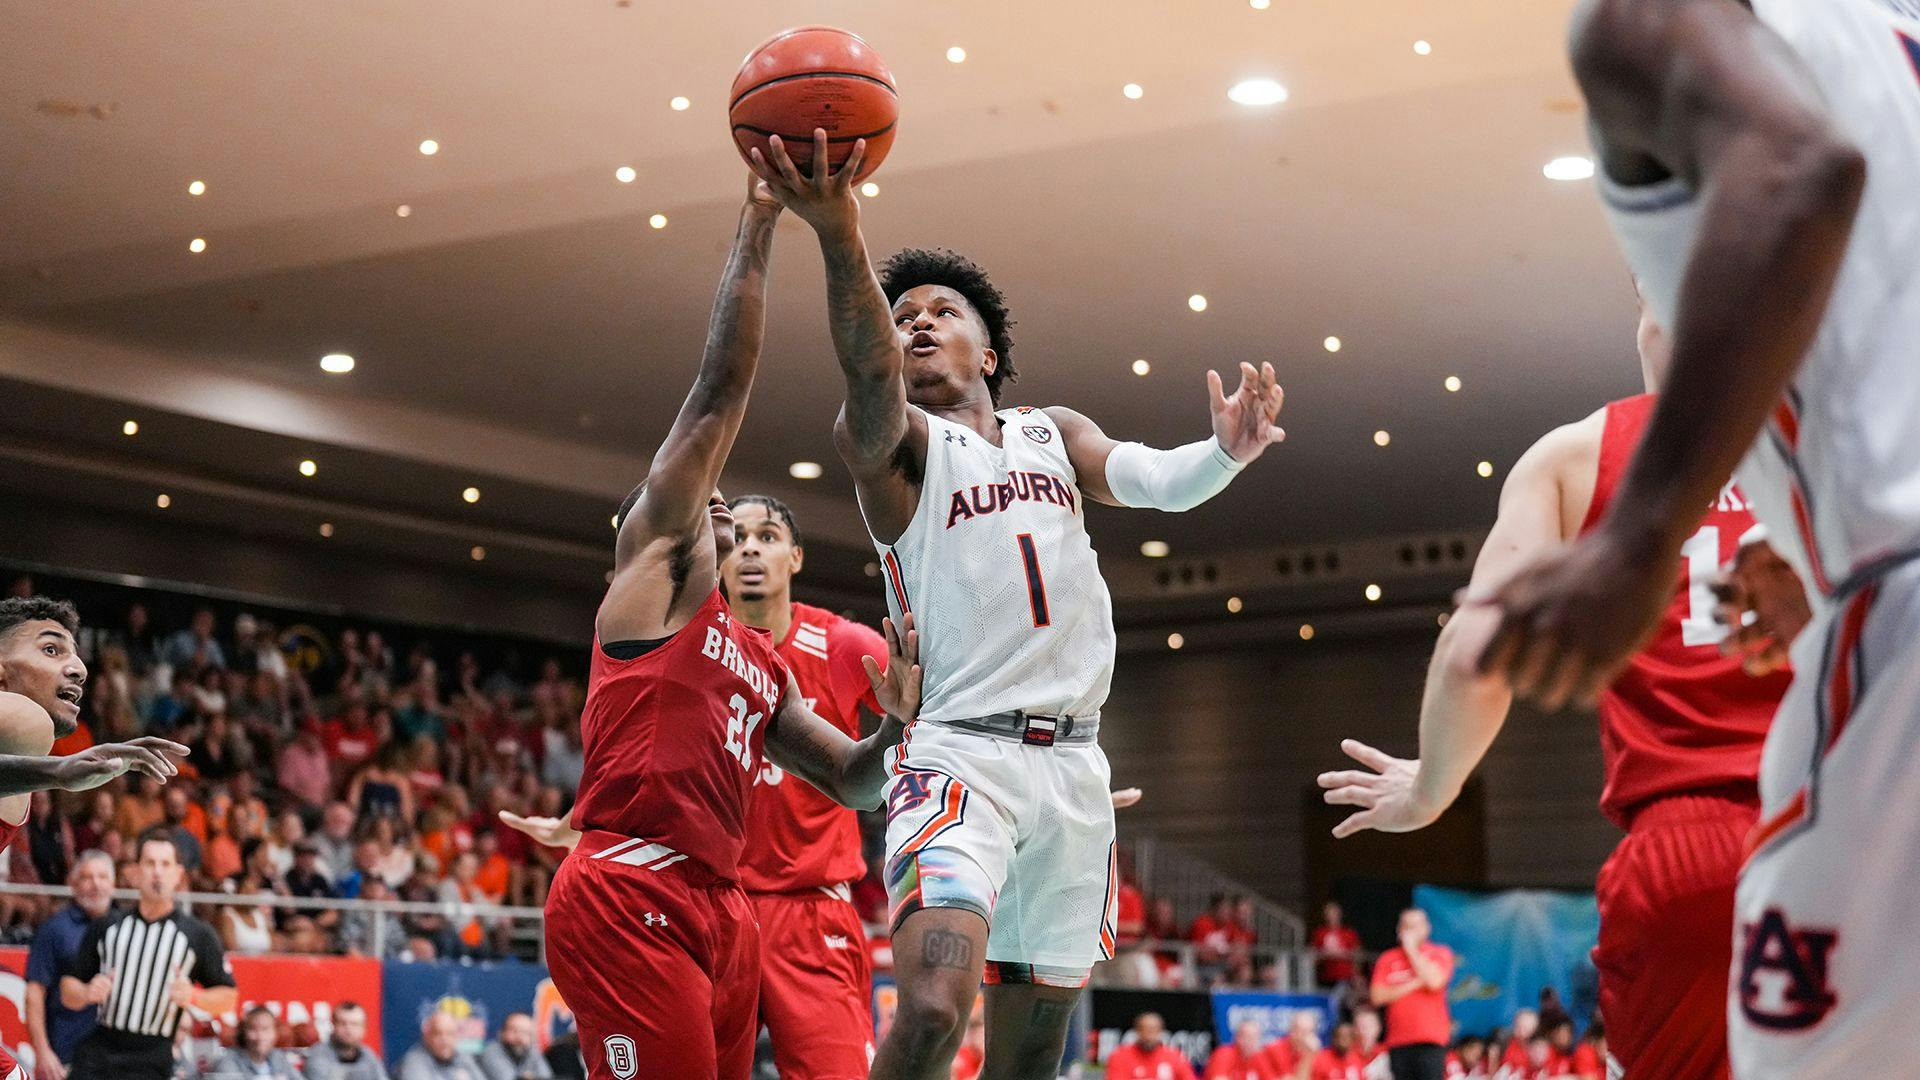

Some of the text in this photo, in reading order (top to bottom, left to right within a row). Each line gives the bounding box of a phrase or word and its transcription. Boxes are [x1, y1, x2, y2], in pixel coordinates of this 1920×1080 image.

[946, 470, 1075, 530] AUBURN
[1016, 533, 1051, 628] 1
[724, 693, 763, 772] 21
